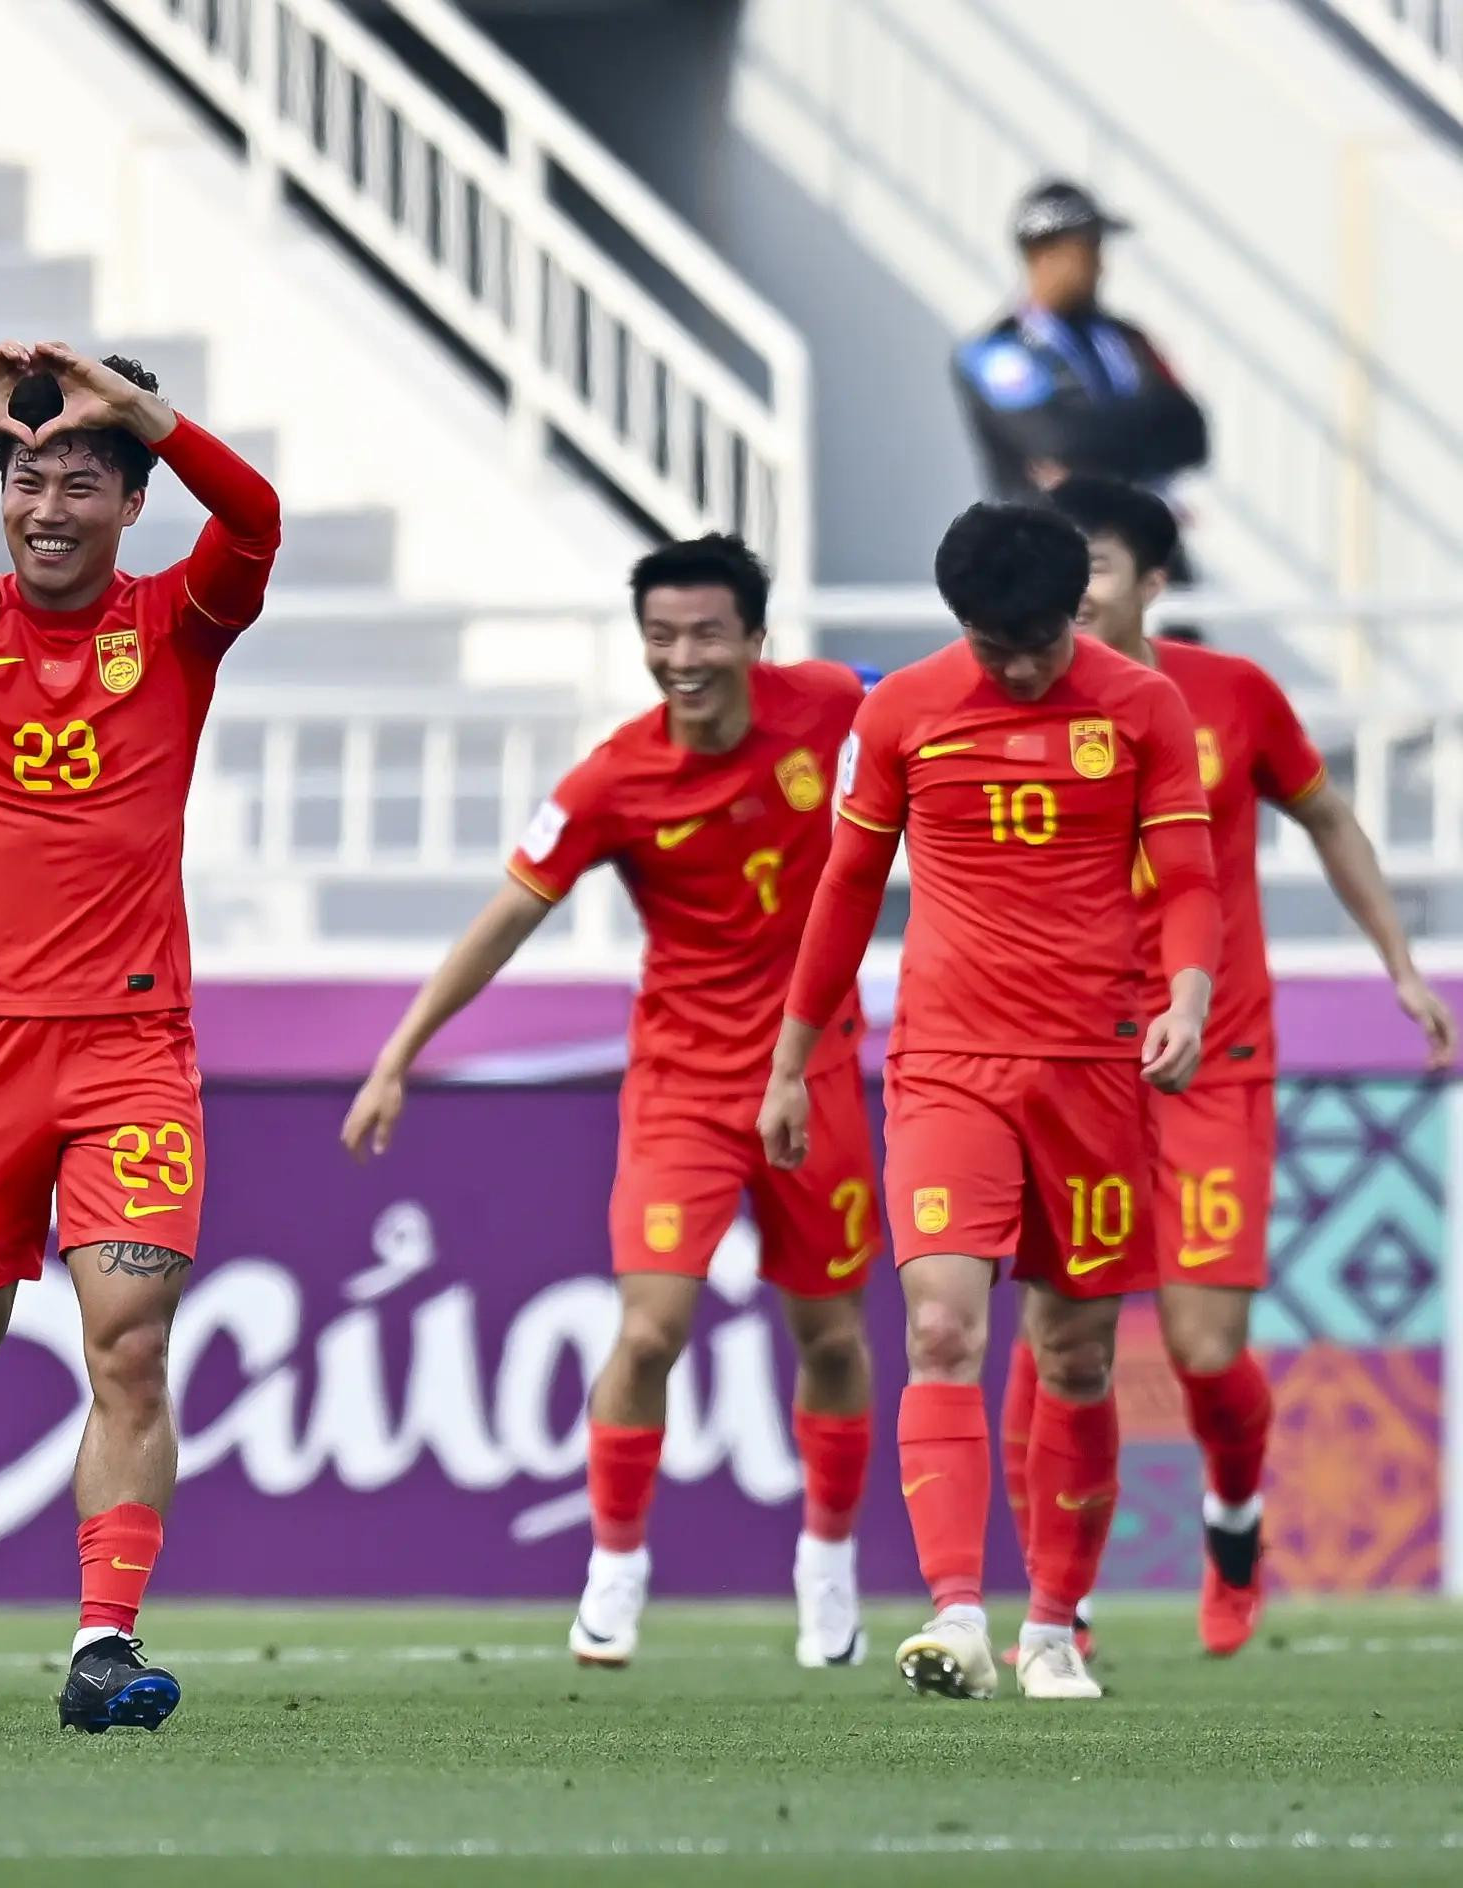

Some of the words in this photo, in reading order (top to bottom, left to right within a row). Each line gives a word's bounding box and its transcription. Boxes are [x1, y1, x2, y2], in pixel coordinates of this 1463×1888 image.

[99, 634, 135, 651] CFA
[13, 720, 102, 792] 23
[982, 783, 1058, 846] 10
[742, 850, 782, 914] 7
[108, 1121, 194, 1196] 23
[1065, 1175, 1133, 1247] 10
[1179, 1169, 1243, 1239] 16
